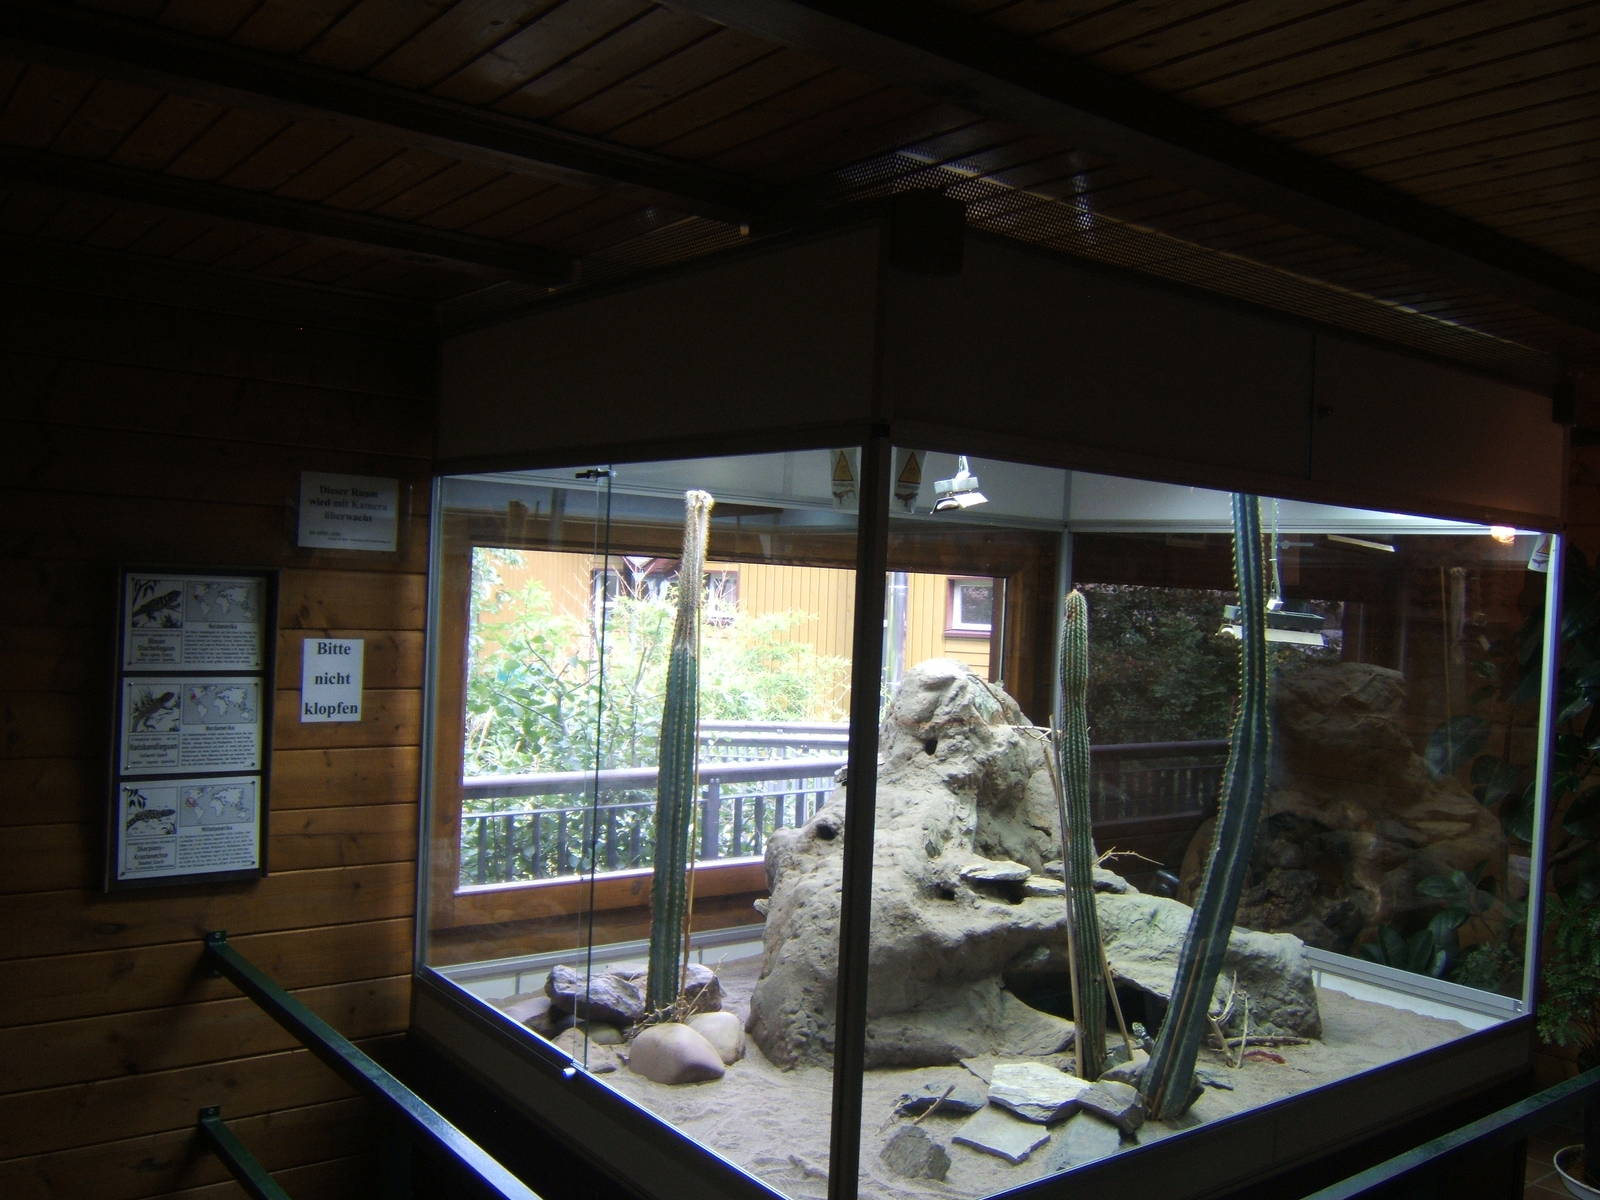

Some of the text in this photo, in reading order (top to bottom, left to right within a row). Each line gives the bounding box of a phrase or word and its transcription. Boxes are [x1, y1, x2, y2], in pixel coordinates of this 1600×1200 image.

[352, 500, 388, 511] Kamera
[318, 642, 351, 655] Bitte
[315, 672, 351, 685] nicht
[304, 702, 358, 718] klopfen
